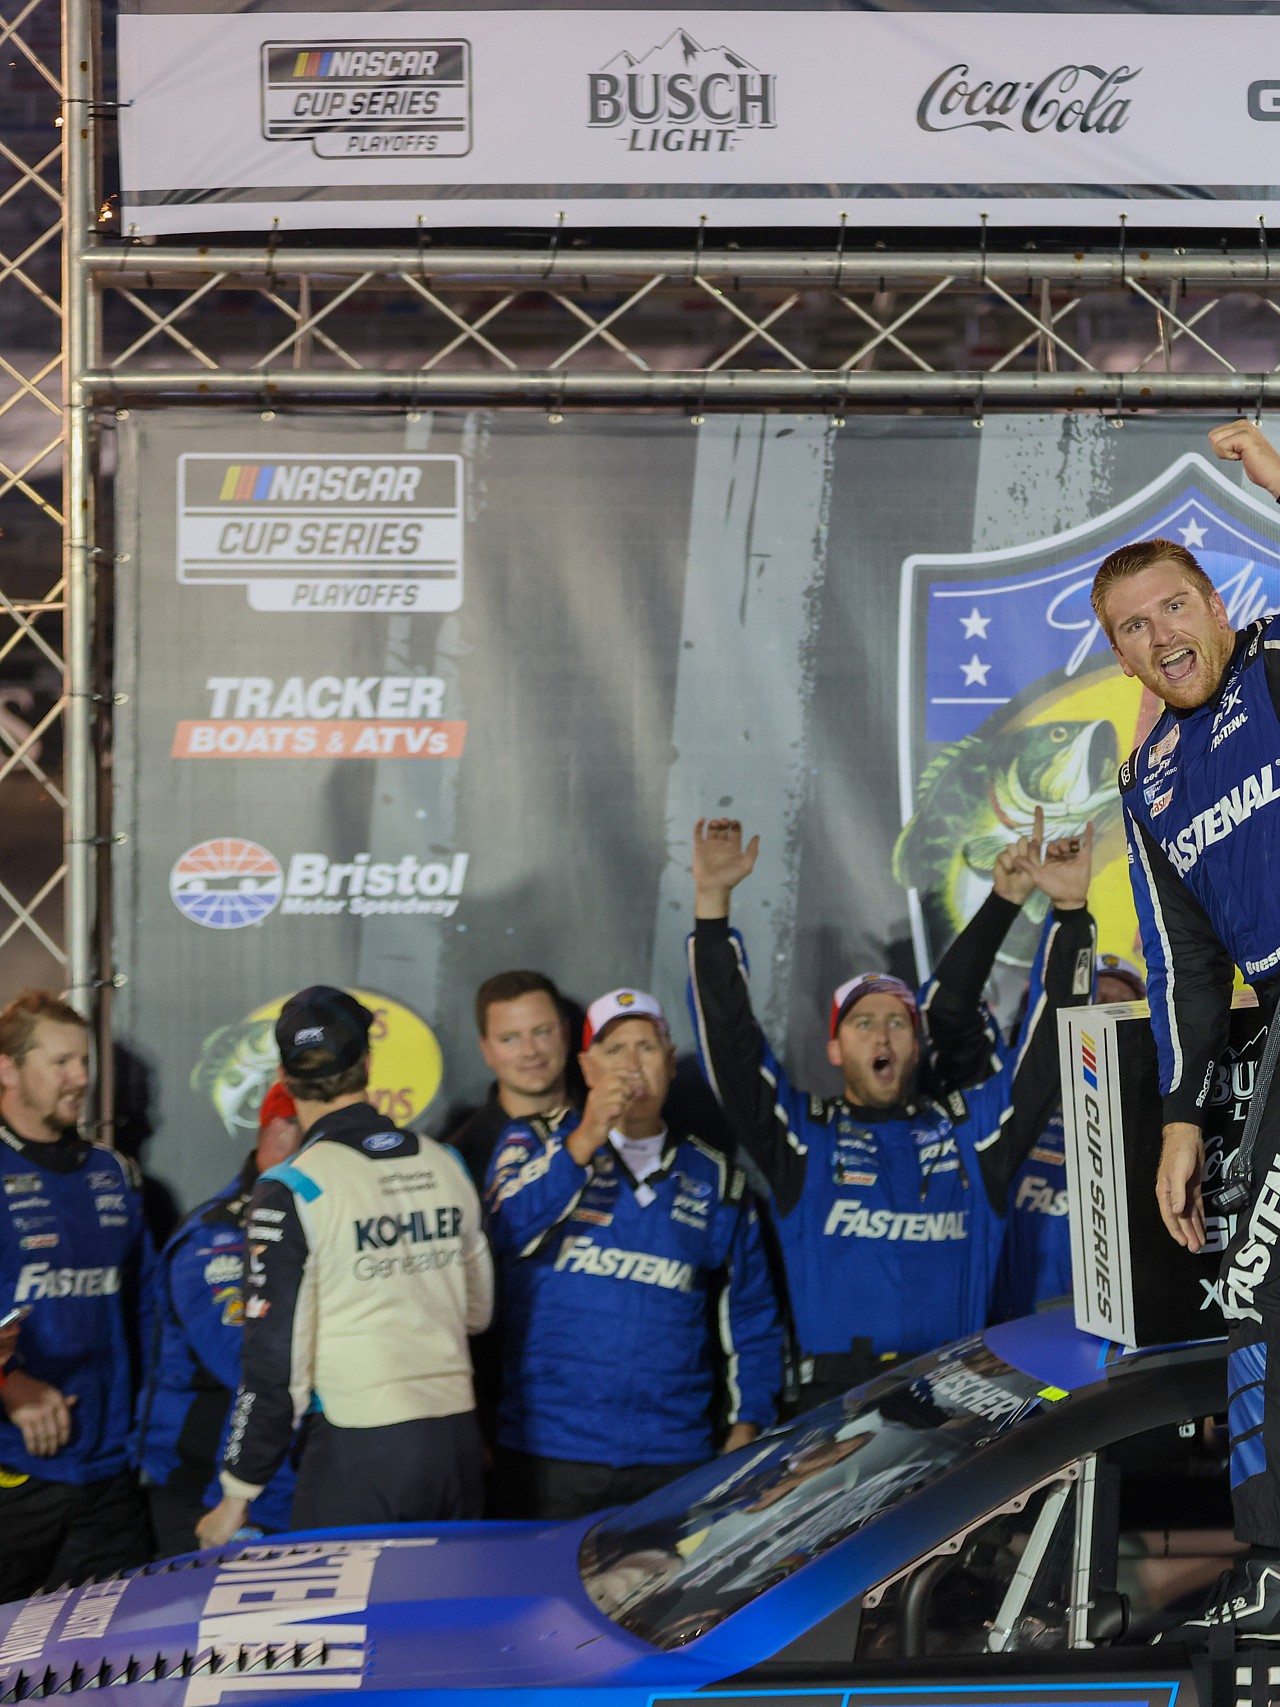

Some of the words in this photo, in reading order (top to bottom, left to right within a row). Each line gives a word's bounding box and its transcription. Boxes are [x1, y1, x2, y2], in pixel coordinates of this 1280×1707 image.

[327, 51, 439, 78] NASCAR
[292, 93, 346, 118] CUP
[350, 91, 440, 116] SERIES
[587, 73, 777, 128] BUSCH
[916, 64, 1144, 134] Coca-Cola
[346, 134, 439, 154] PLAYOFFS
[627, 129, 737, 152] LIGHT
[269, 465, 422, 502] NASCAR
[218, 522, 291, 556] CUP
[296, 522, 425, 556] SERIES
[292, 584, 420, 606] PLAYOFFS
[206, 677, 447, 719] TRACKER
[187, 727, 318, 754] BOATS
[326, 731, 347, 753] &
[353, 727, 449, 754] ATVs
[286, 852, 470, 897] Bristol
[280, 897, 346, 915] Motor
[348, 898, 460, 917] Speedway
[1084, 1093, 1104, 1178] CUP
[354, 1206, 465, 1253] KOHLER
[823, 1199, 969, 1242] FASTENAL
[554, 1235, 697, 1293] FASTENA
[1090, 1179, 1112, 1324] SERIES
[185, 1538, 438, 1707] STENAL
